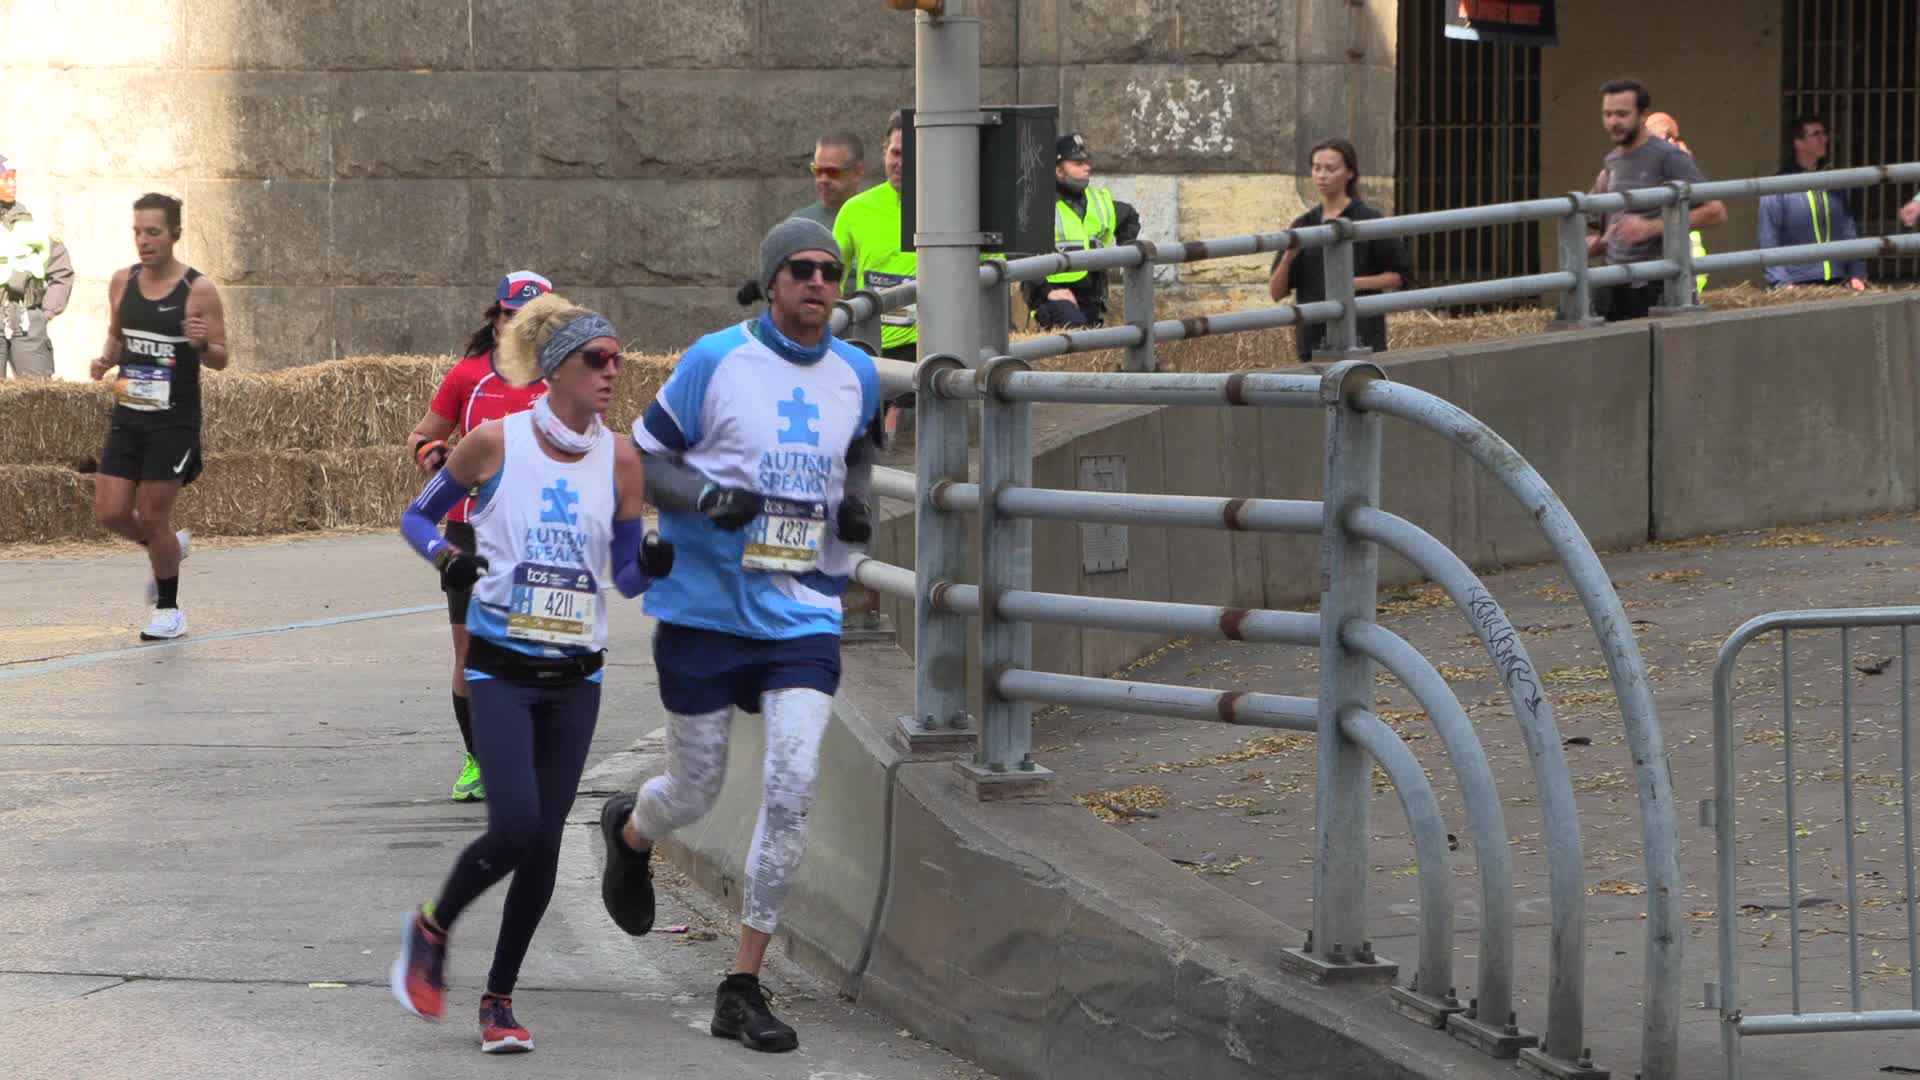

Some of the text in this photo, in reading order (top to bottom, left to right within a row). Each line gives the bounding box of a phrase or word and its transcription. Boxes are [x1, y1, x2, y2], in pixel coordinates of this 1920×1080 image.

[759, 450, 832, 475] AUTISM
[775, 520, 809, 546] 4231
[527, 567, 549, 584] tcs
[544, 591, 574, 618] 4211
